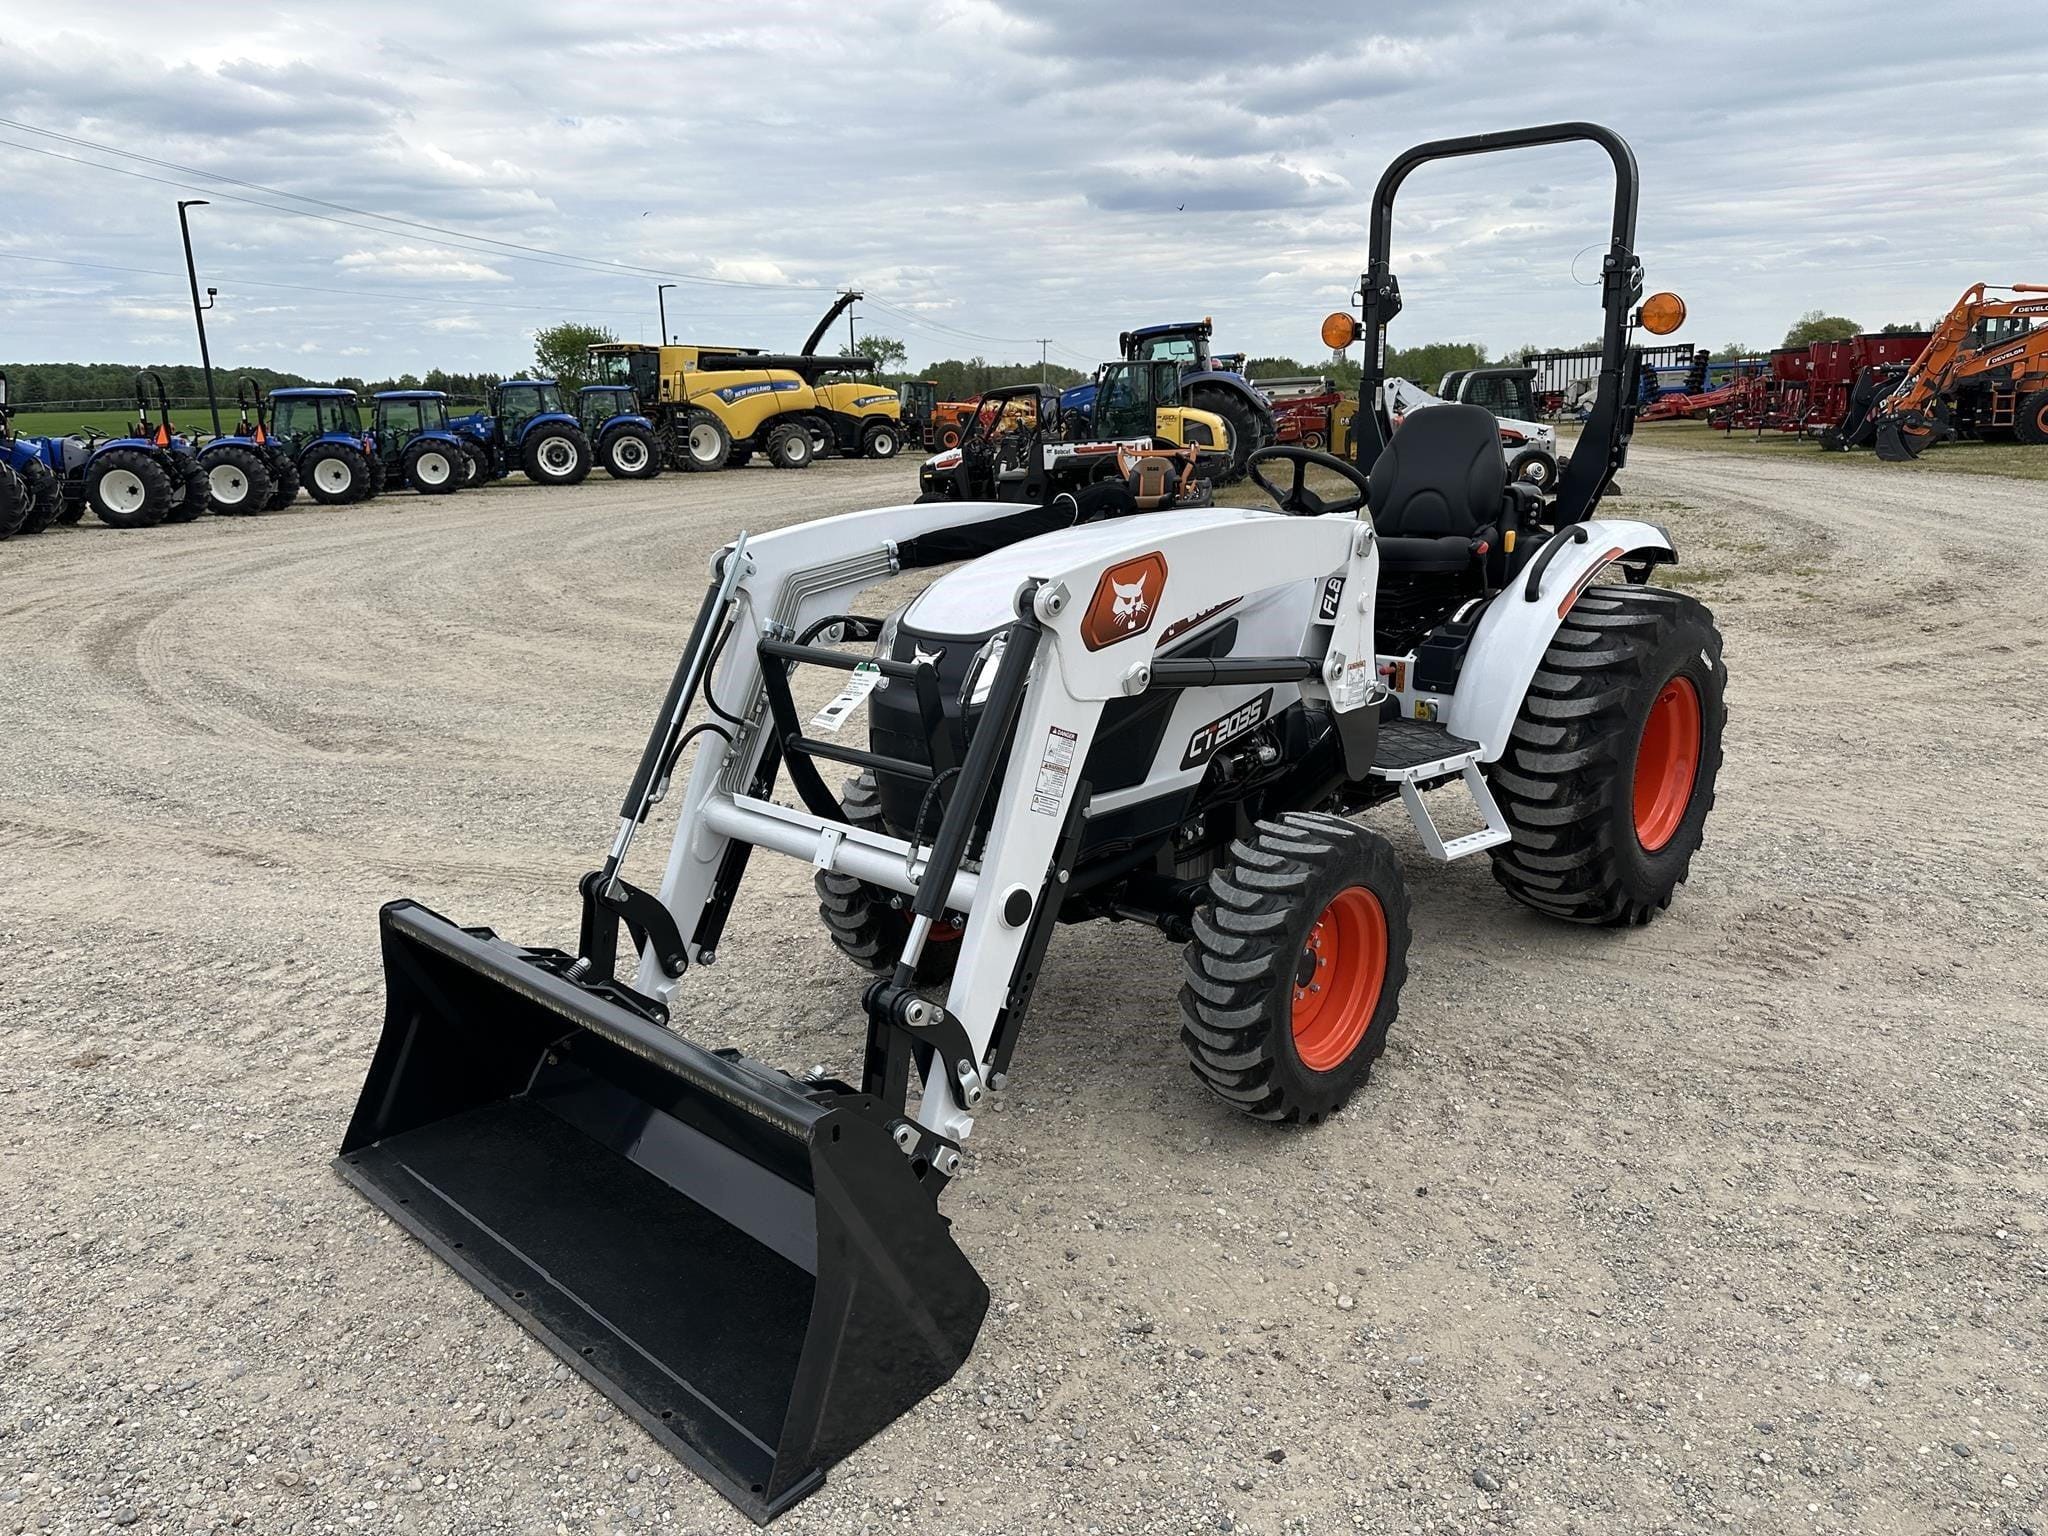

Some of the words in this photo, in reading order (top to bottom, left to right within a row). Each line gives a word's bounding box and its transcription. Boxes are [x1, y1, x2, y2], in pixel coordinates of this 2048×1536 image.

[1991, 347, 2024, 363] DEVELON
[735, 389, 747, 398] NEW
[747, 385, 771, 394] HOLLAND
[1340, 417, 1350, 426] CA
[1323, 578, 1342, 616] FL8
[1190, 698, 1263, 758] CT2035
